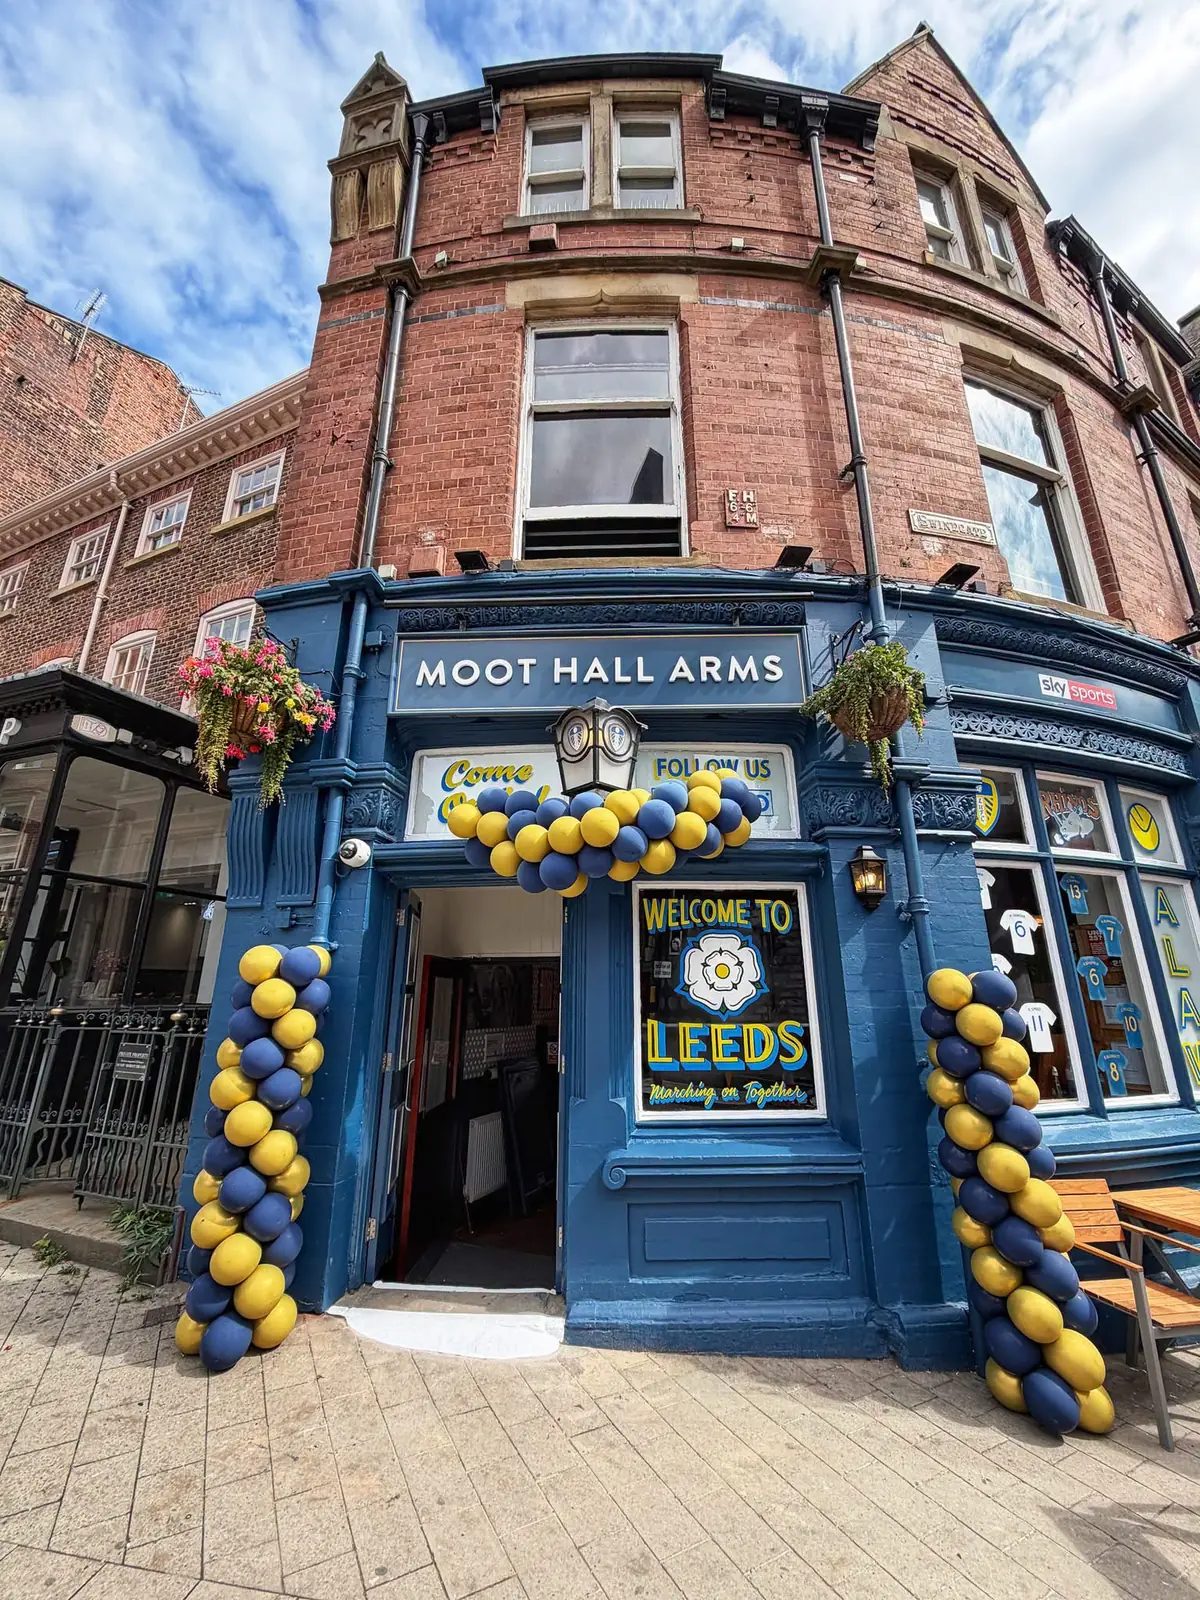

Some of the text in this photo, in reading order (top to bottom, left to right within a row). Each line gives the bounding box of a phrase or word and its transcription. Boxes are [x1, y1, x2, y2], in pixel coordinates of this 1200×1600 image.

[416, 654, 784, 687] MOOT HALL ARMS
[1042, 676, 1114, 705] sky sports
[441, 759, 533, 792] Come
[744, 758, 772, 781] US
[1069, 883, 1082, 900] 13
[643, 898, 793, 933] WELCOME TO
[1014, 920, 1026, 938] 6
[1105, 926, 1115, 941] 7
[1089, 967, 1100, 986] 6
[1031, 1015, 1044, 1032] 11
[1124, 1015, 1138, 1032] 10
[647, 1018, 807, 1071] LEEDS
[1109, 1062, 1120, 1082] 8
[649, 1080, 807, 1108] Marching on Together
